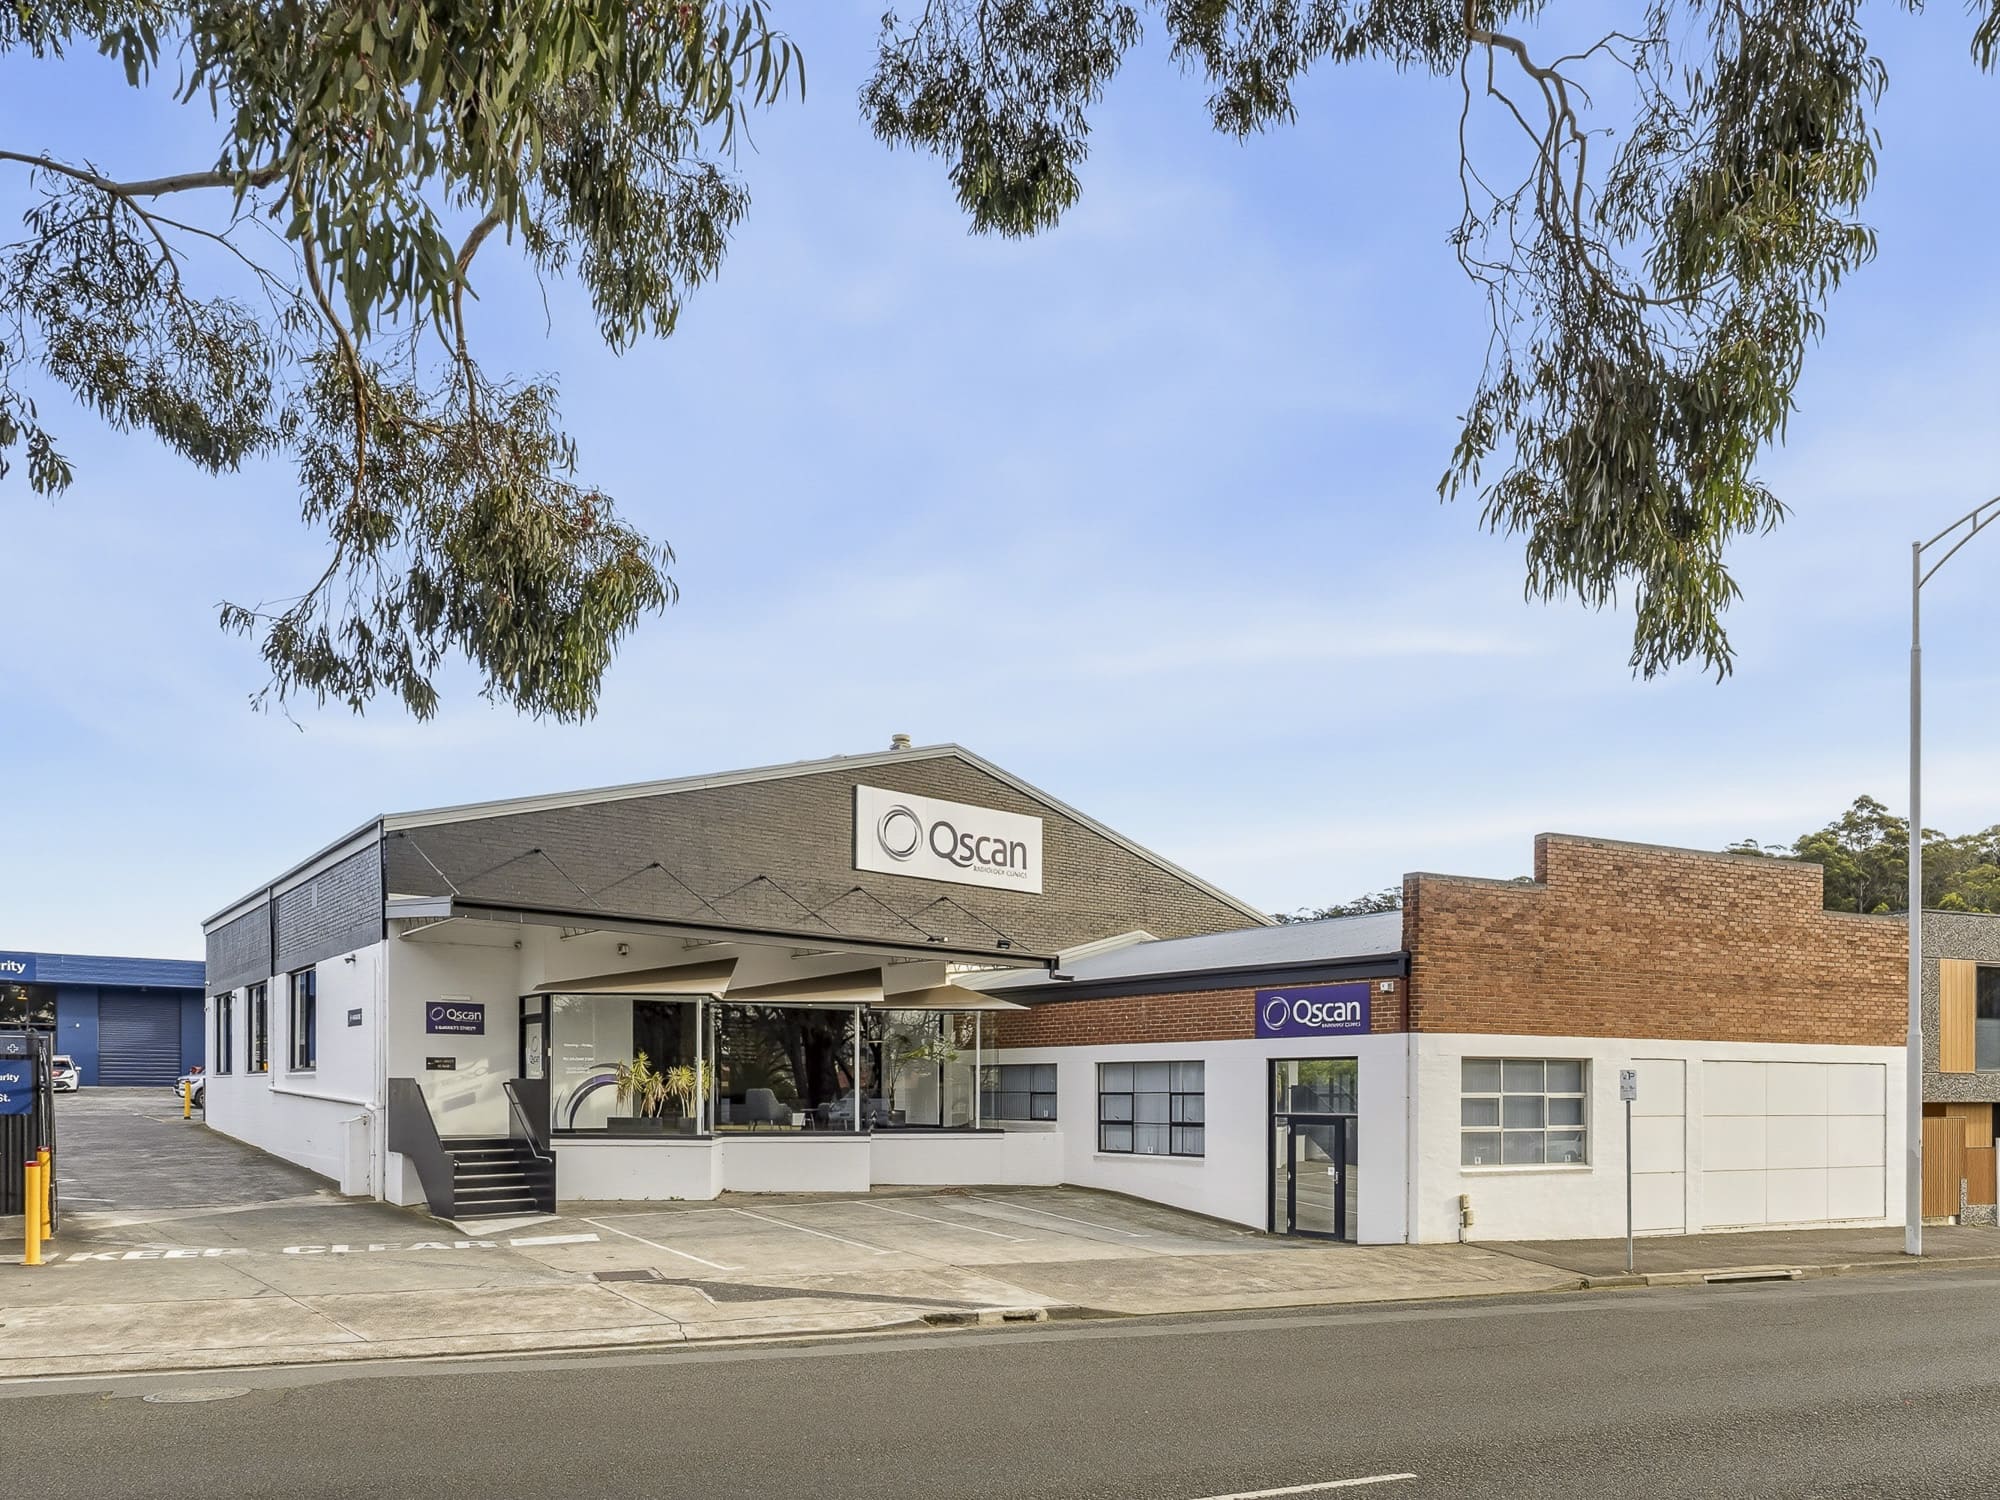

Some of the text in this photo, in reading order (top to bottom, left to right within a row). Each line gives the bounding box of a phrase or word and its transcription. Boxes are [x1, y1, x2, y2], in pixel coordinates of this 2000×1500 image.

[929, 820, 1027, 870] Qscan
[446, 1008, 482, 1021] Qscan
[1292, 999, 1361, 1027] Qscan
[64, 1240, 499, 1262] KEEP CLEAR
